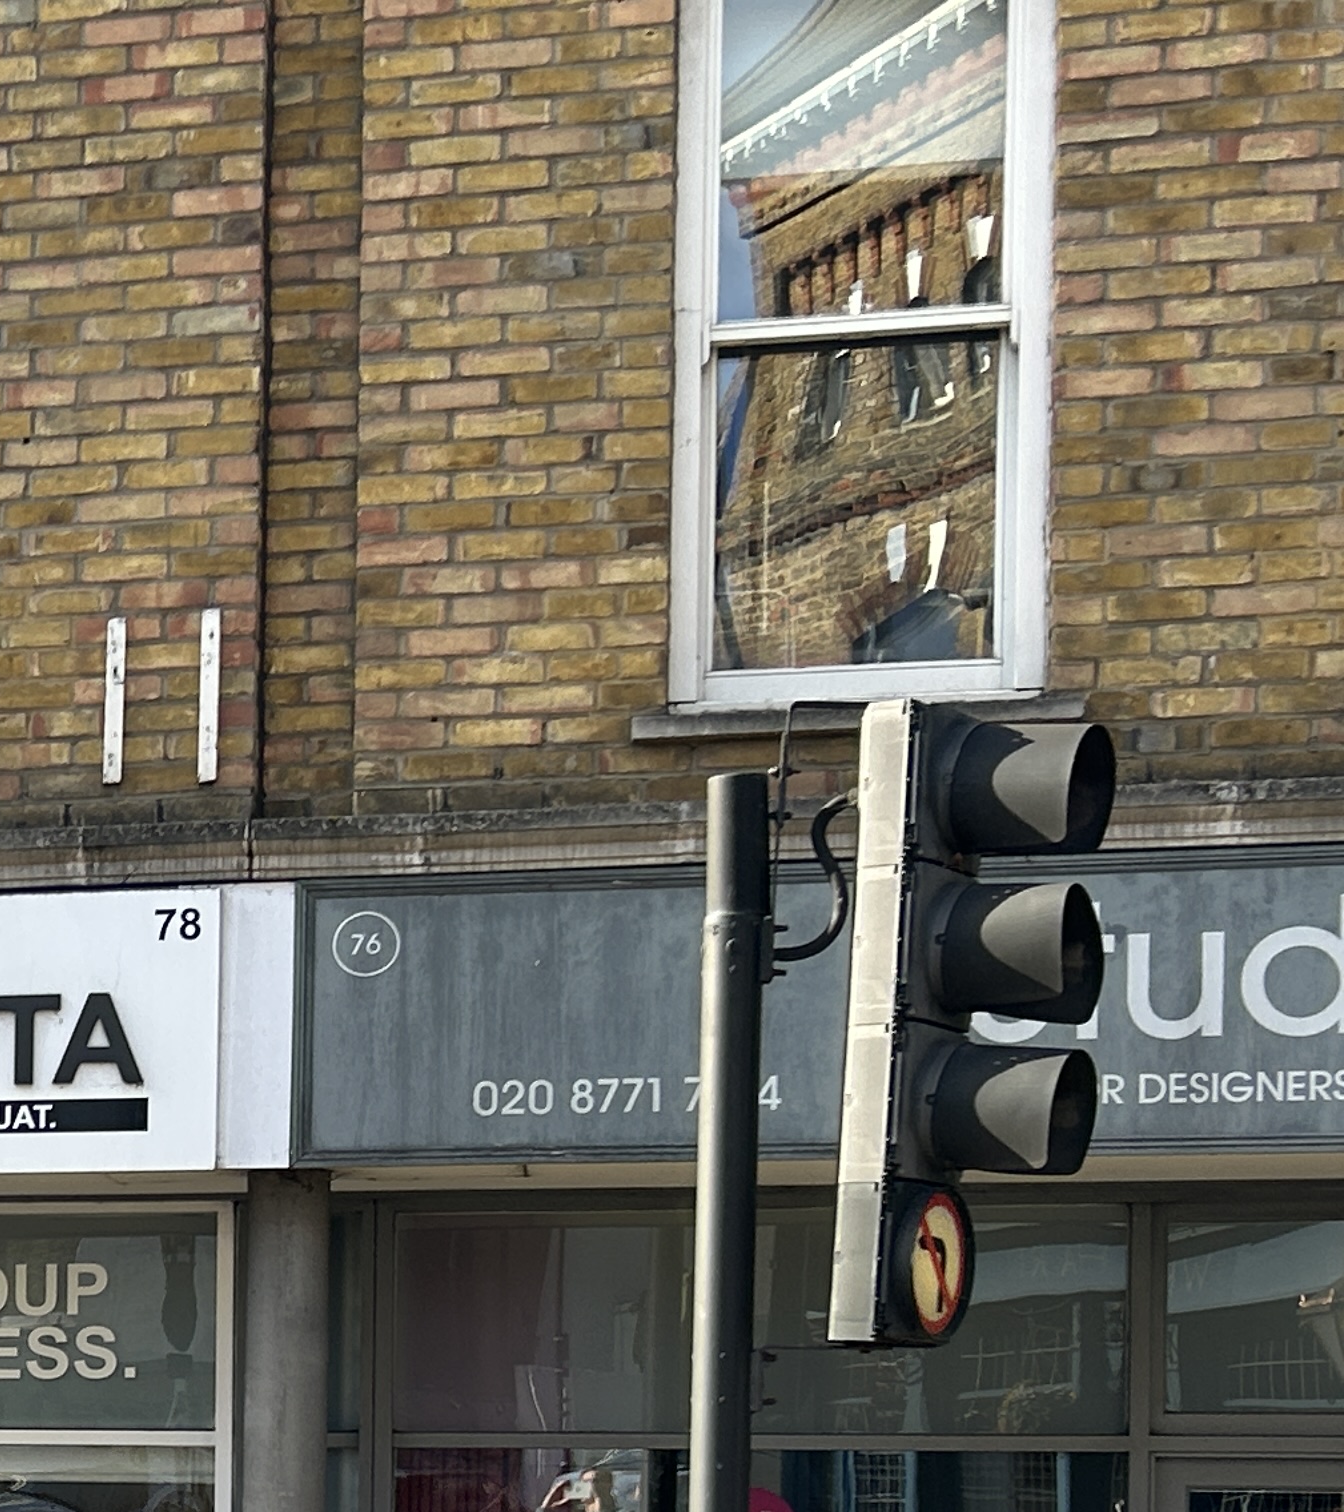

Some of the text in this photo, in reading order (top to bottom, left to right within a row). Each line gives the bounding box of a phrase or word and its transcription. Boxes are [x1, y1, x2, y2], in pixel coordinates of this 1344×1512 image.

[155, 907, 202, 941] 78
[350, 932, 381, 956] 76
[472, 1074, 783, 1117] 020 8771 74
[1138, 1070, 1344, 1105] DESIGNERS
